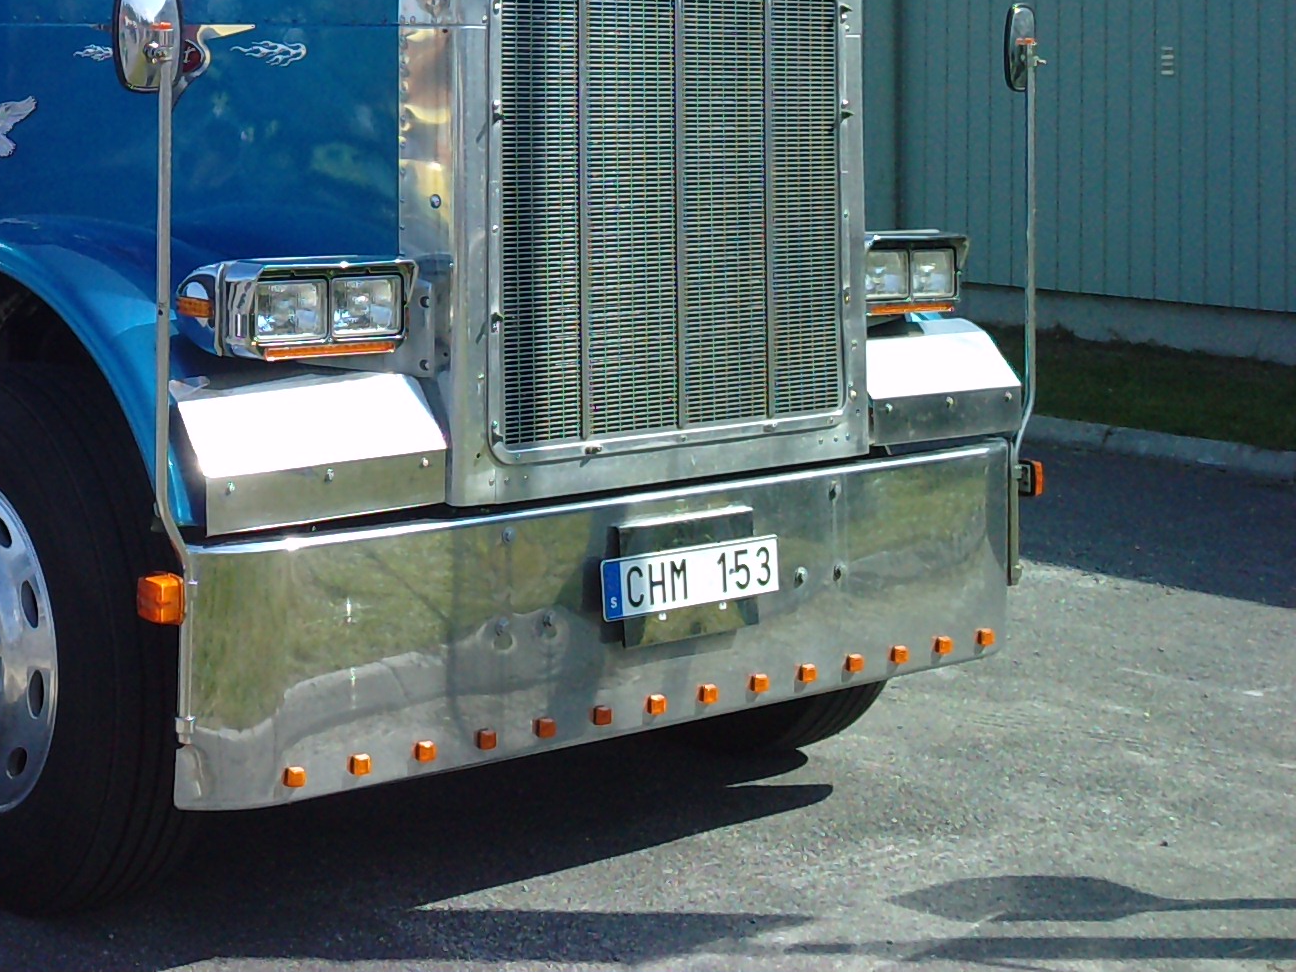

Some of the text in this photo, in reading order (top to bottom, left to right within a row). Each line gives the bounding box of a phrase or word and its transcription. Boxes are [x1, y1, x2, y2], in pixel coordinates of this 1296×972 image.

[626, 546, 771, 609] CHM 153
[610, 596, 618, 609] S
